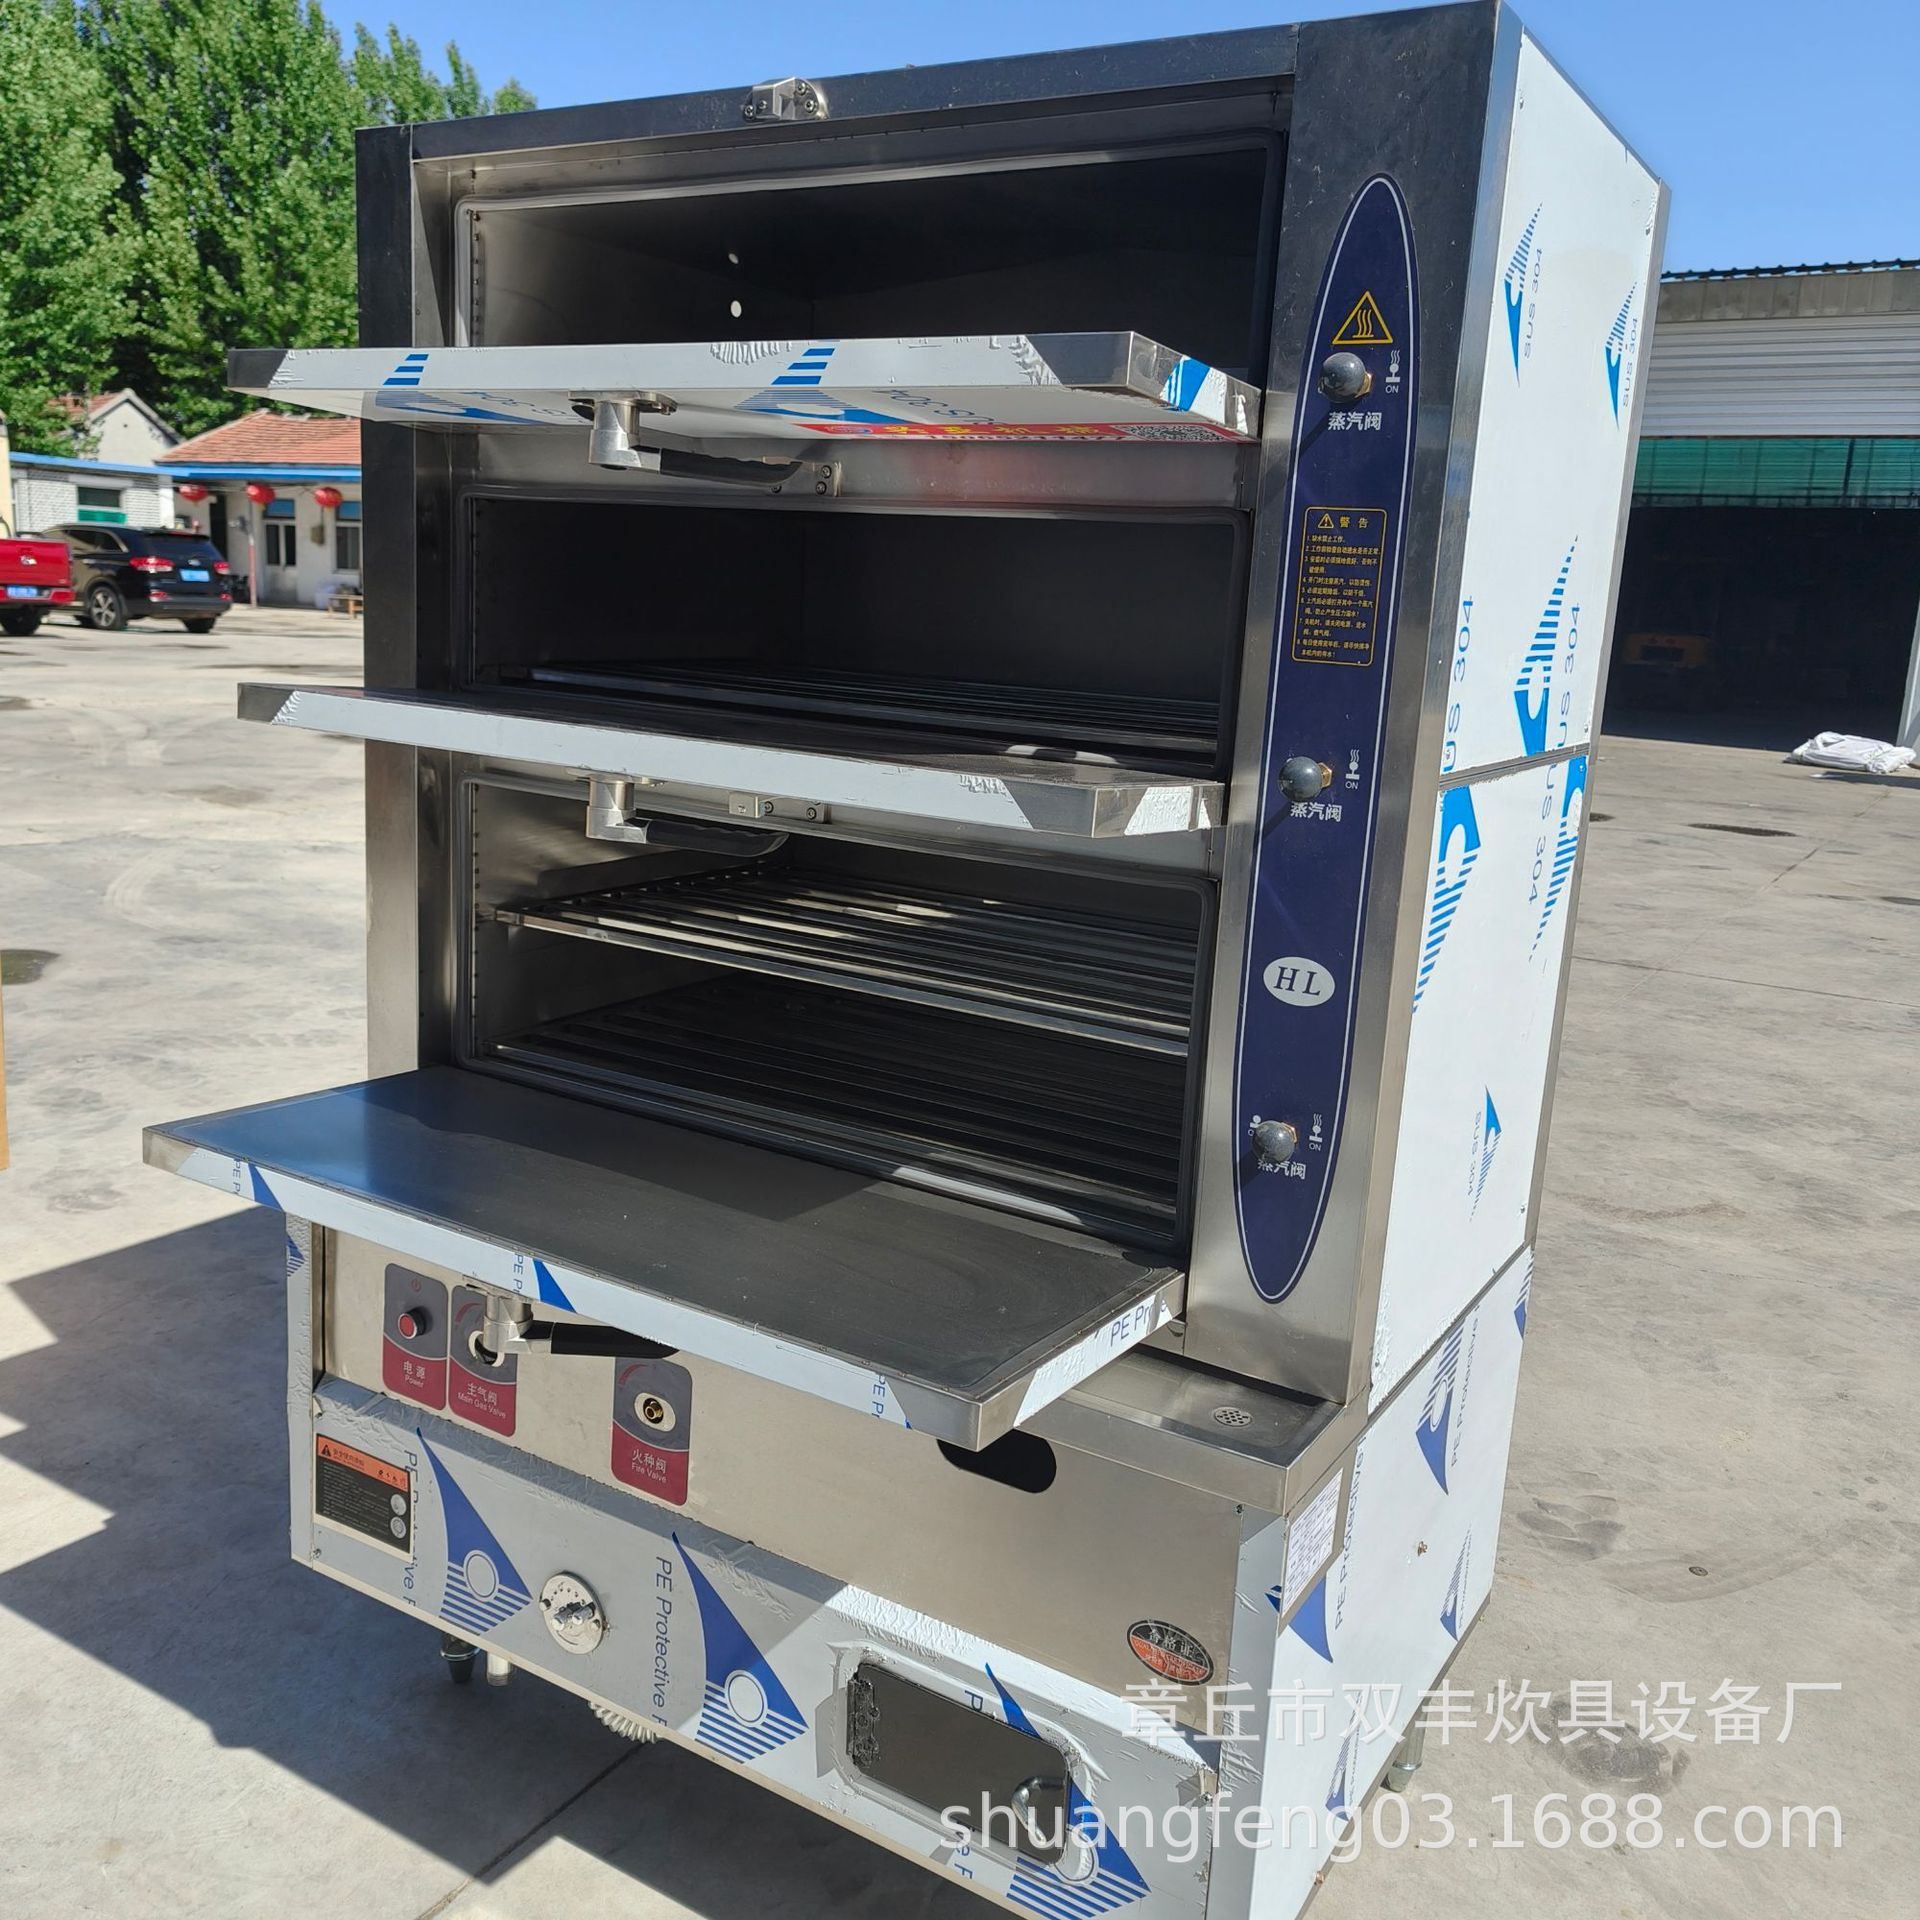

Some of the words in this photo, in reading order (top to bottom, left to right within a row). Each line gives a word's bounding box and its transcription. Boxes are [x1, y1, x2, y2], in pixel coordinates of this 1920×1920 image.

[1531, 247, 1543, 294] 304
[1385, 385, 1399, 394] ON
[1327, 411, 1382, 431] 蒸汽阀
[1453, 595, 1475, 683] 304
[1553, 691, 1571, 751] US
[1564, 602, 1581, 674] 304
[1345, 781, 1359, 790] ON
[1290, 801, 1343, 823] 蒸汽阀
[1528, 835, 1546, 905] 304
[1308, 1142, 1322, 1152] ON
[513, 1252, 524, 1275] PE
[1110, 1312, 1131, 1348] PE
[403, 1360, 426, 1380] 电源
[404, 1374, 424, 1388] Power
[467, 1382, 497, 1406] 主气阀
[631, 1448, 667, 1474] 火种阀
[631, 1461, 645, 1475] Fire
[646, 1468, 667, 1484] Valve
[656, 1556, 673, 1592] PE
[1335, 1585, 1347, 1631] PE
[652, 1595, 673, 1708] Protective
